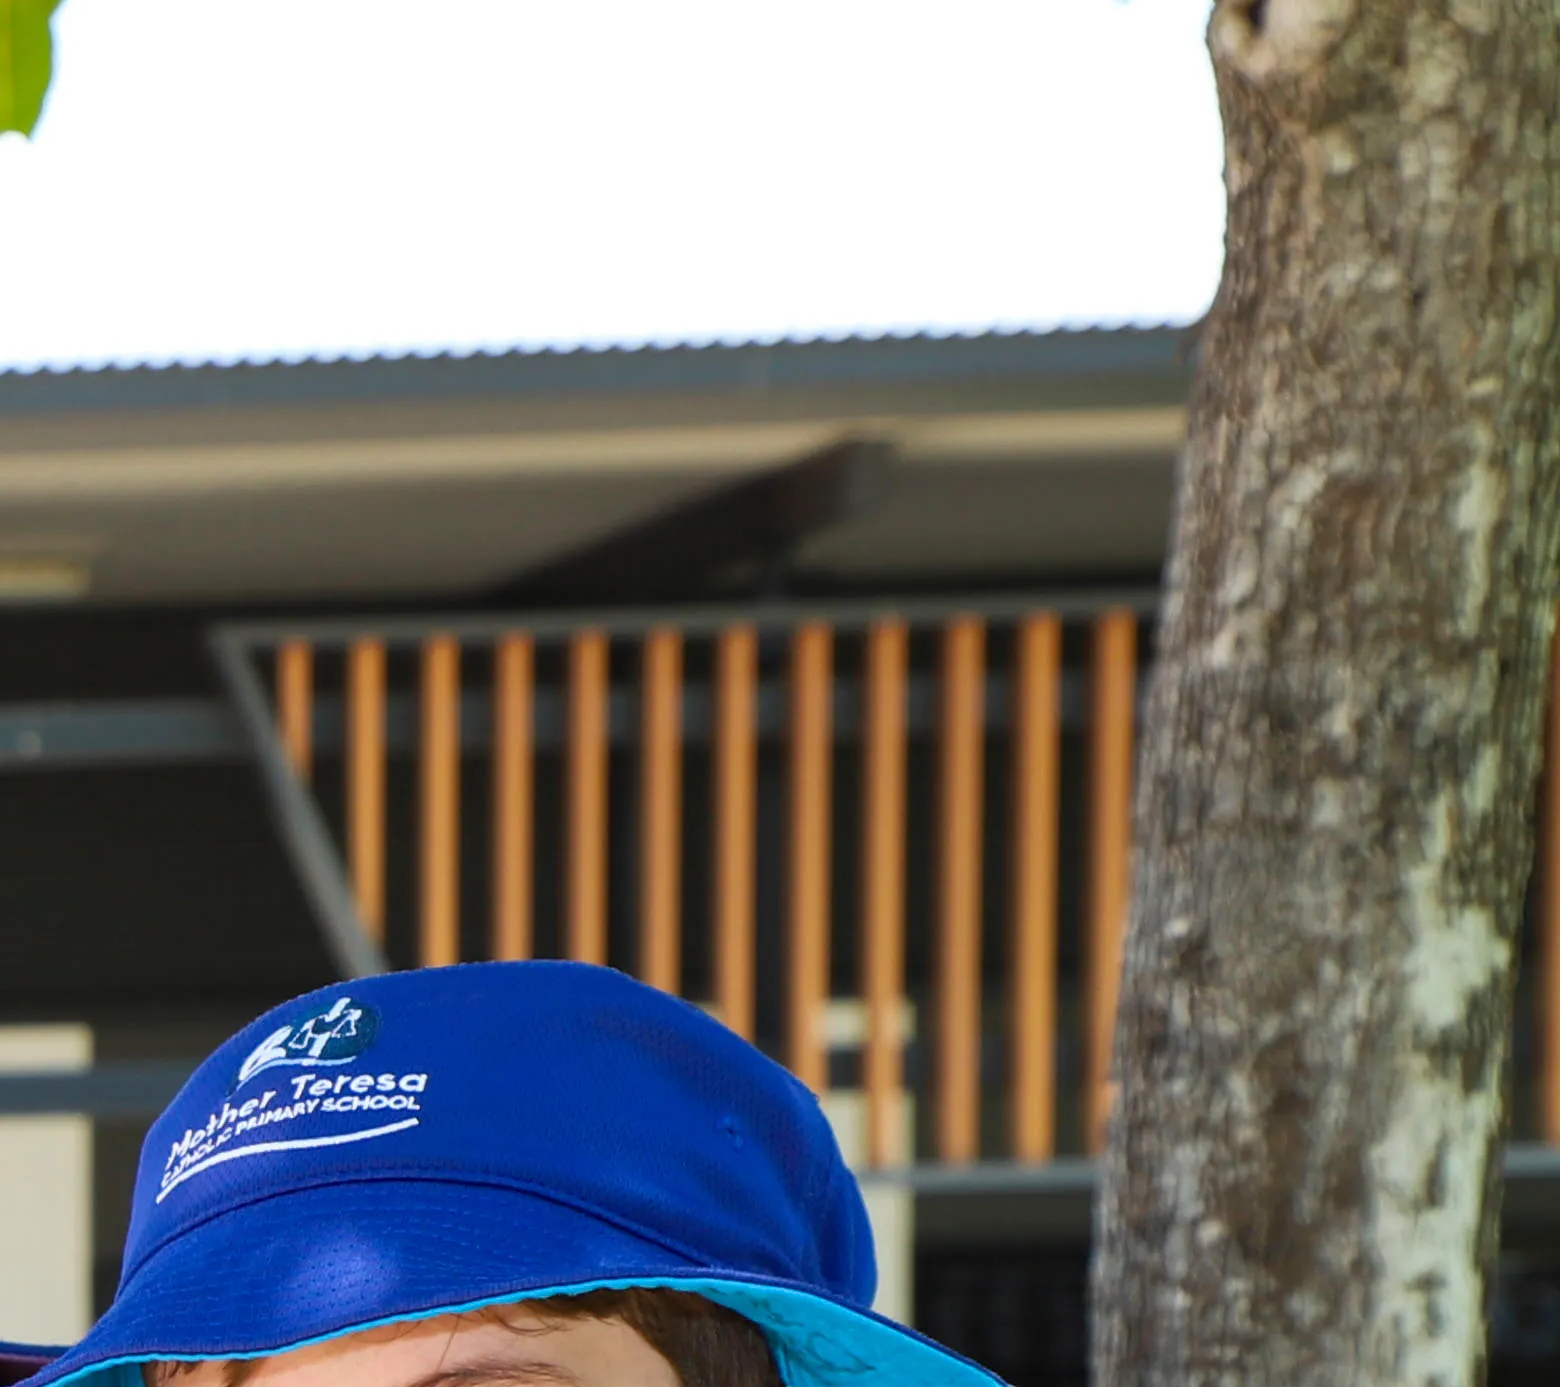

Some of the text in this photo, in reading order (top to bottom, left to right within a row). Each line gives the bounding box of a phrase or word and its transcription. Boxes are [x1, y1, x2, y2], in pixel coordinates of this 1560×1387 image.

[165, 1072, 427, 1170] Mother Teresa
[235, 1098, 320, 1136] PRIMARY
[320, 1094, 420, 1112] SCHOOL
